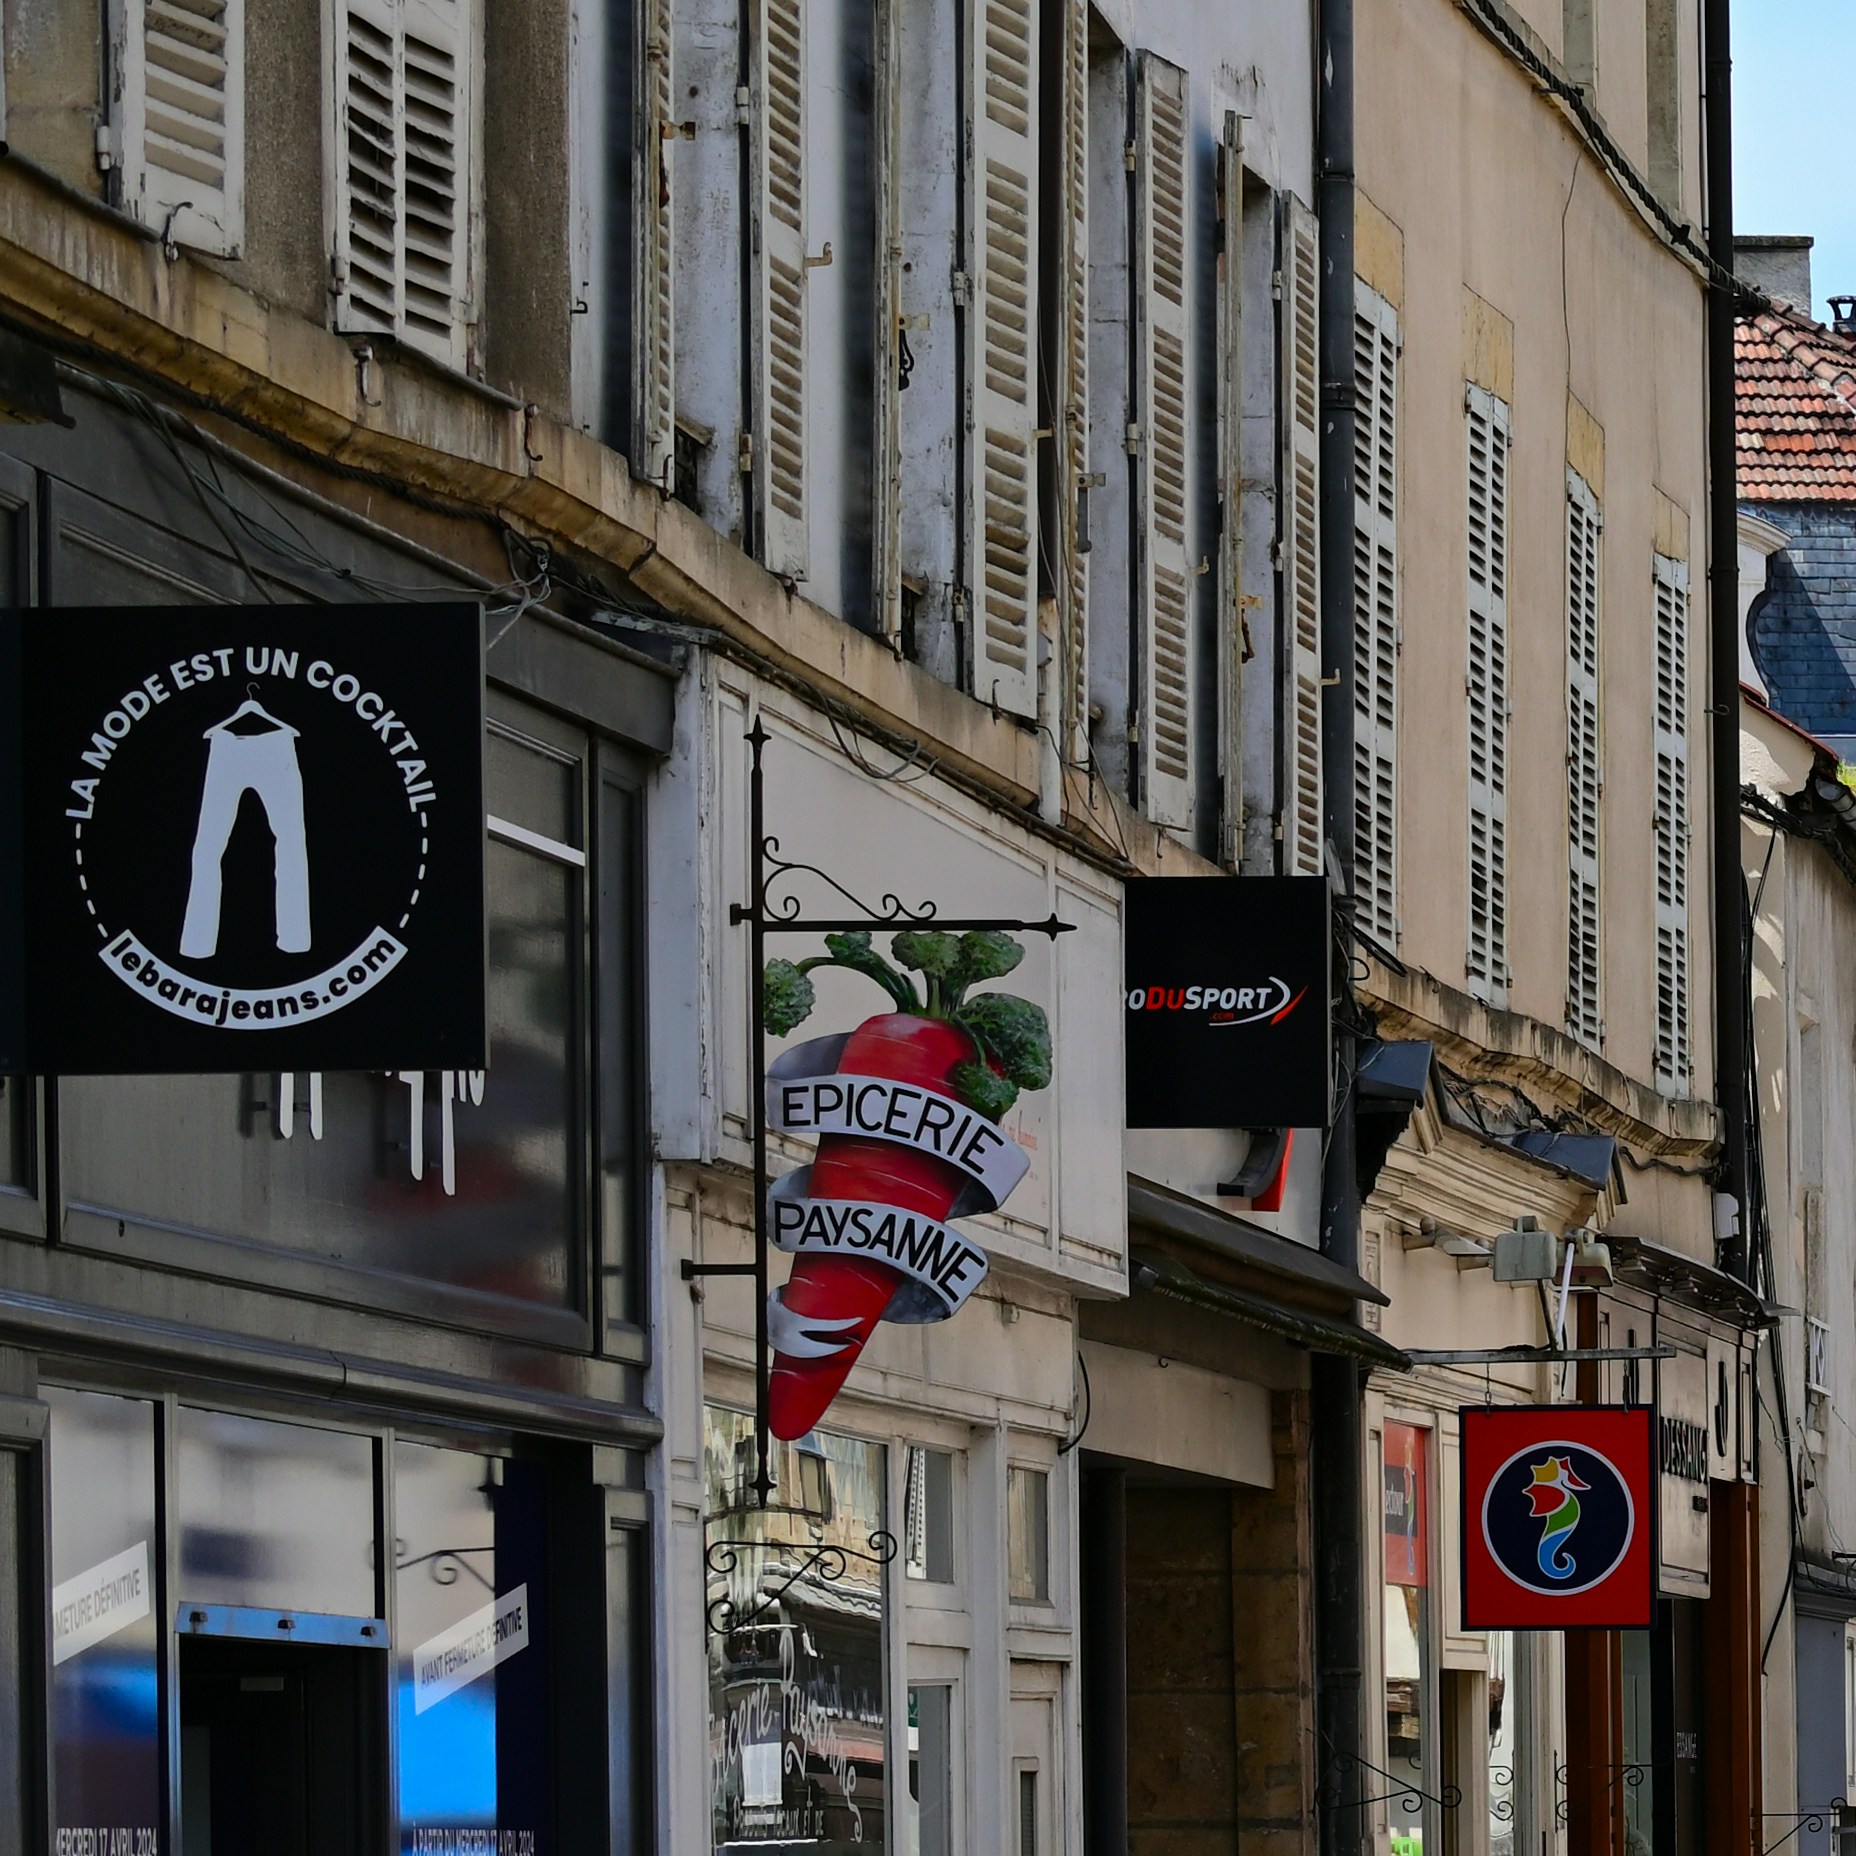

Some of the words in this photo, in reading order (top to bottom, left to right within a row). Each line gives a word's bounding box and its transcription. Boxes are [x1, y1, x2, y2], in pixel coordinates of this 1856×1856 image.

[170, 648, 234, 690] EST
[245, 647, 299, 679] UN
[81, 674, 170, 770] MODE
[307, 660, 436, 812] COCKTAIL
[66, 778, 99, 819] LA
[110, 937, 397, 1026] lebarajeans.com
[782, 1083, 1004, 1175] EPICERIE
[774, 1200, 985, 1303] PAYSANNE
[421, 1655, 443, 1689] AVANT
